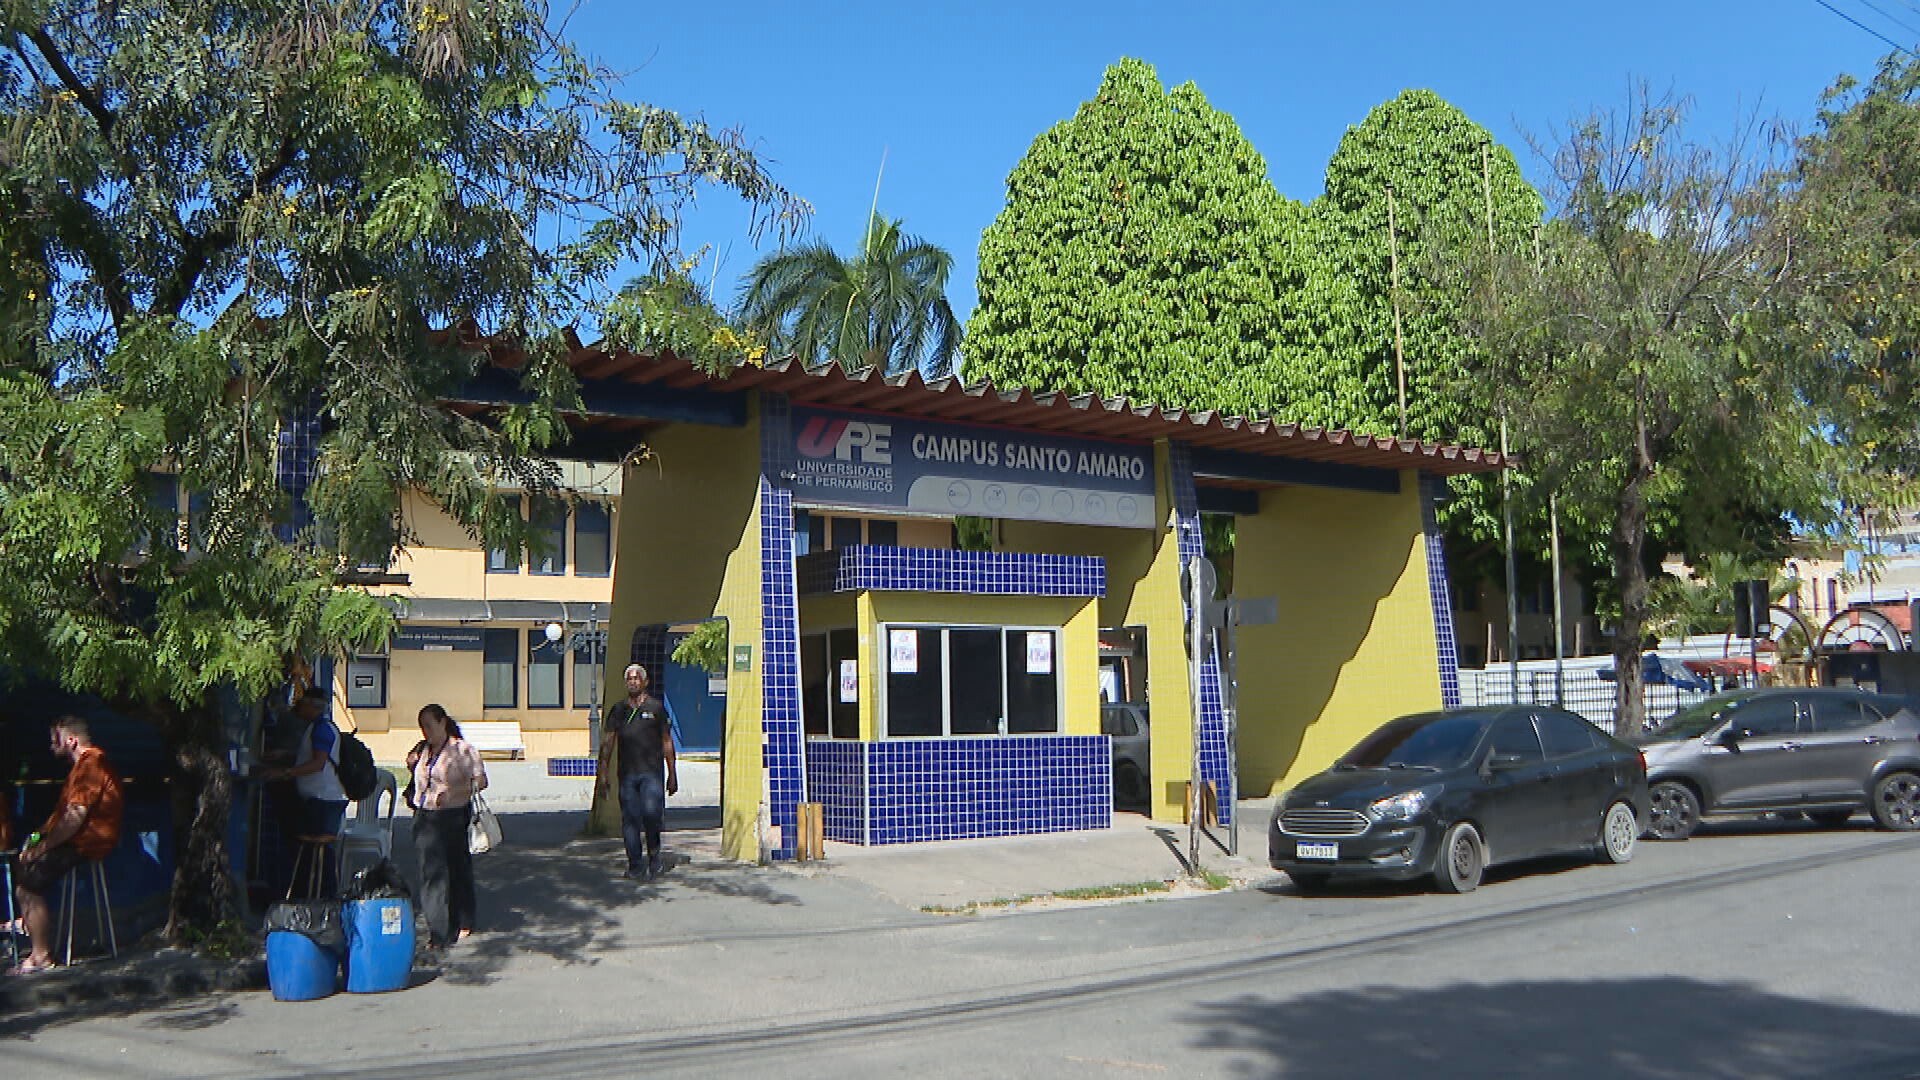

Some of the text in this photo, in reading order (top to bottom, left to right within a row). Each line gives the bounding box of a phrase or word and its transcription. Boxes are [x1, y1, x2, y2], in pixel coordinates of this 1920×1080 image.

[797, 416, 892, 464] UPE
[911, 433, 1145, 480] CAMPUS SANTO AMARO
[797, 460, 892, 479] UNIVERSIDADE
[797, 474, 893, 493] DE PERNAMBUCO
